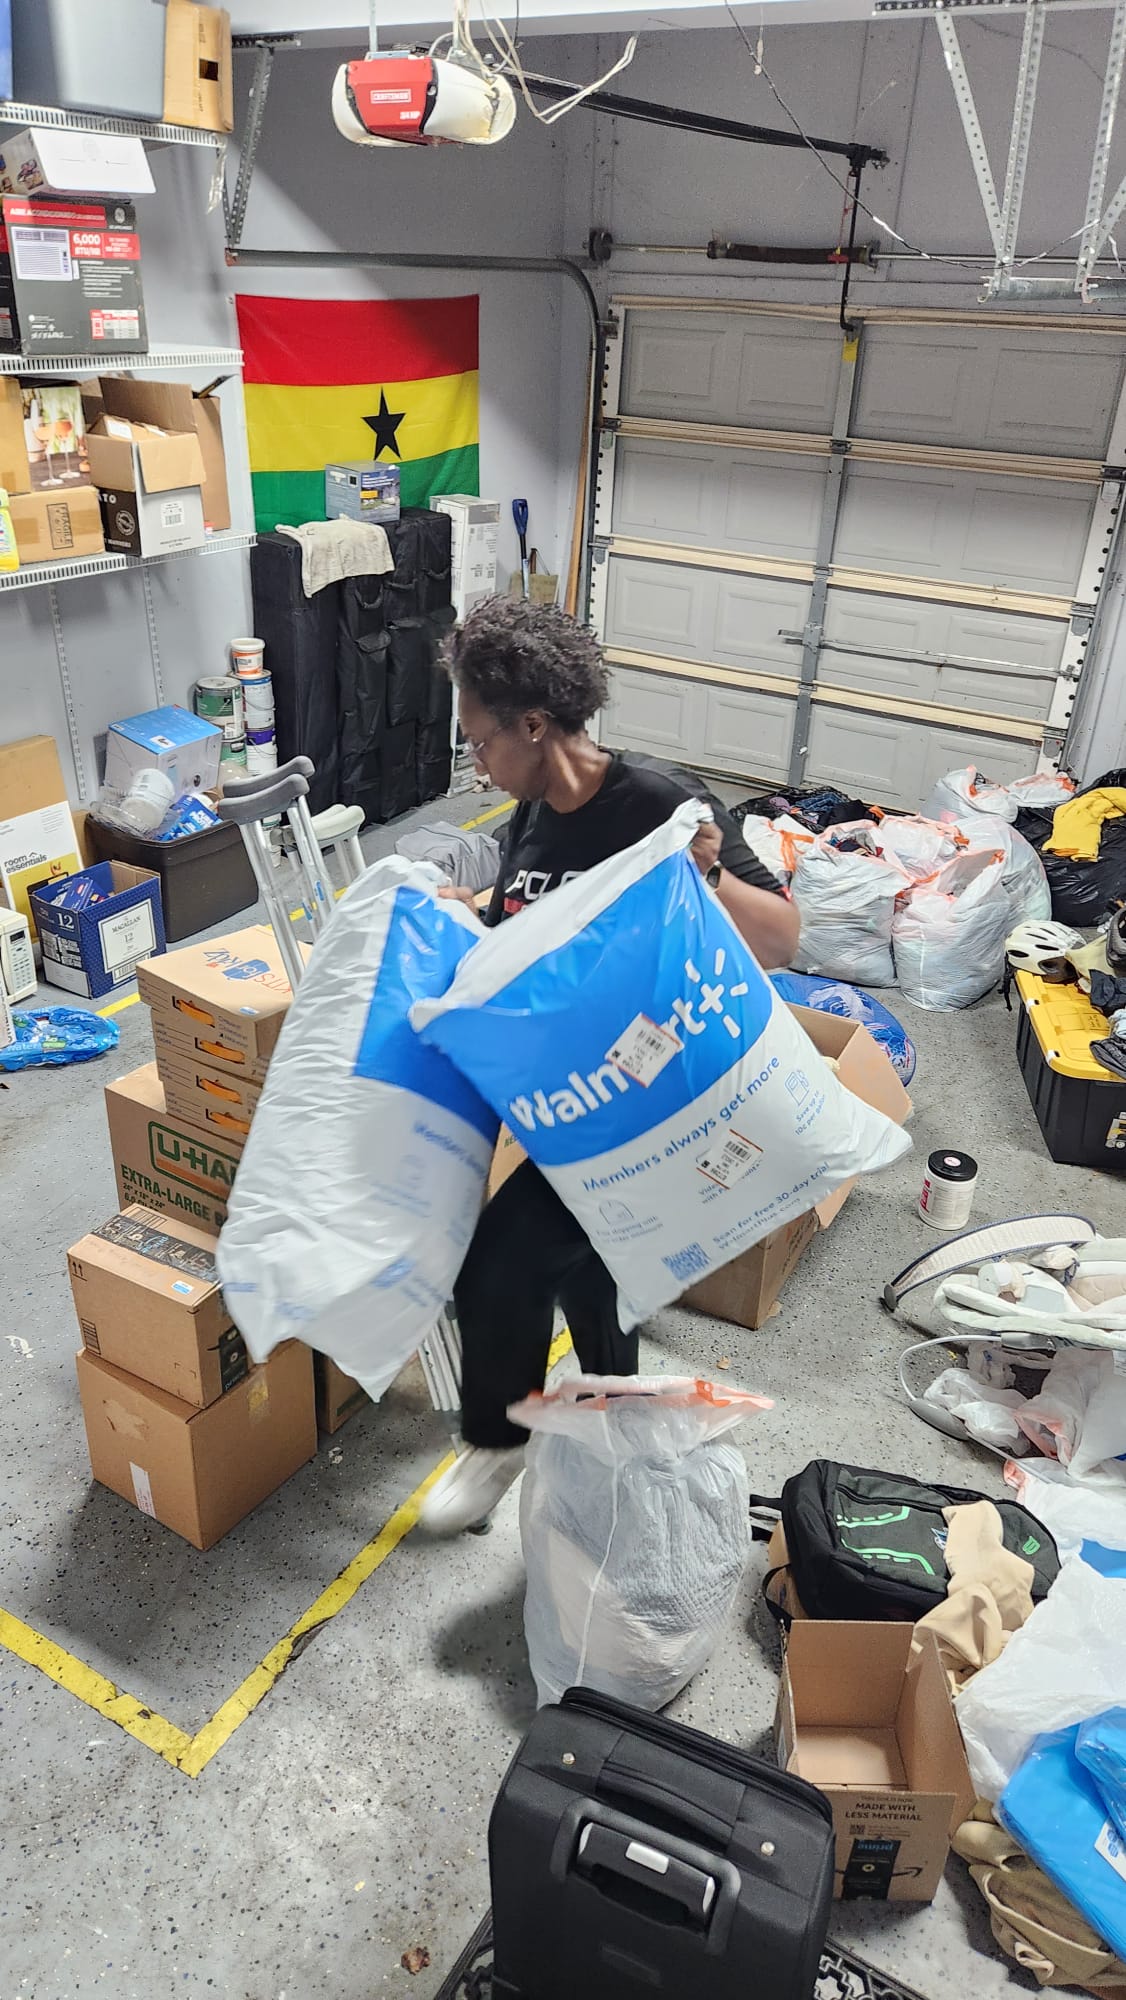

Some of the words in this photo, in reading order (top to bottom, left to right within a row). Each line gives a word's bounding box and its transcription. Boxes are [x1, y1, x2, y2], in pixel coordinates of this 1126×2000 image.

[73, 233, 101, 246] 6,000
[4, 854, 28, 868] room
[6, 854, 48, 874] essentials
[57, 912, 75, 930] 12
[583, 1154, 661, 1192] Members
[664, 1117, 717, 1156] always
[719, 1091, 746, 1121] get
[747, 1056, 780, 1096] more
[121, 1163, 211, 1221] EXTRA-LARGE
[713, 1227, 737, 1243] Scan
[737, 1216, 752, 1229] for
[754, 1202, 775, 1217] free
[776, 1179, 809, 1203] 30-day
[810, 1161, 830, 1180] trial
[855, 1802, 886, 1811] MADE
[888, 1803, 916, 1811] WITH
[845, 1811, 869, 1819] LESS
[872, 1812, 923, 1822] MATERIAL
